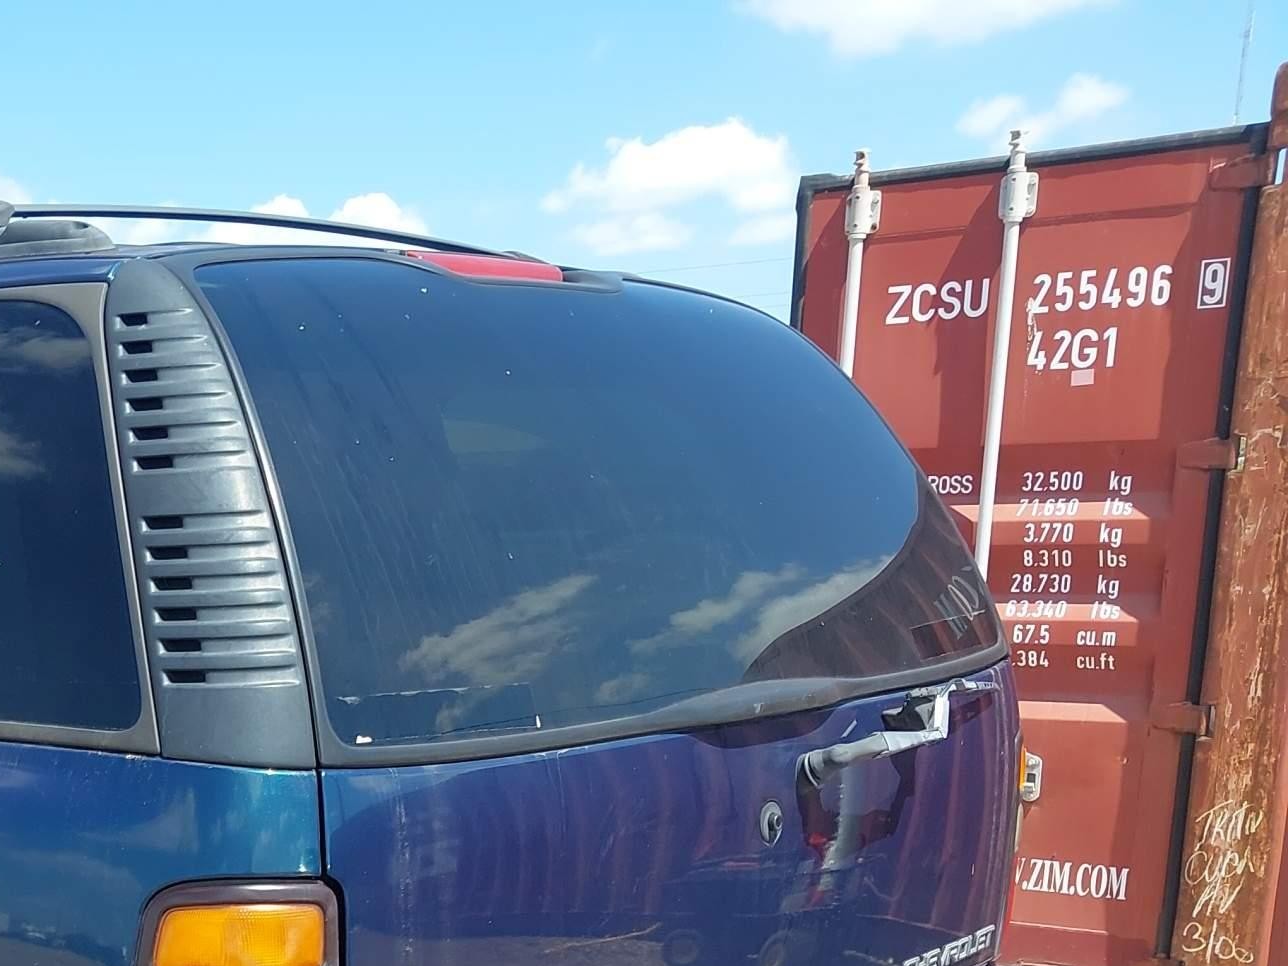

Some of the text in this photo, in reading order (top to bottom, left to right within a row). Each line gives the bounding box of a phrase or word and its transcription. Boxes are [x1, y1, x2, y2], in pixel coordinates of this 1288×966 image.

[885, 260, 1228, 325] ZCSU 255496 9
[1027, 327, 1118, 371] 42G1
[926, 475, 974, 495] ROSS
[1109, 471, 1132, 495] kg
[1102, 497, 1133, 517] lbs
[1099, 523, 1123, 547] kg
[1098, 550, 1127, 568] lbs
[1096, 574, 1120, 599] kg
[1090, 600, 1121, 619] lbs
[1012, 624, 1116, 646] 67.5 cu.m
[1076, 654, 1115, 670] cu.ft
